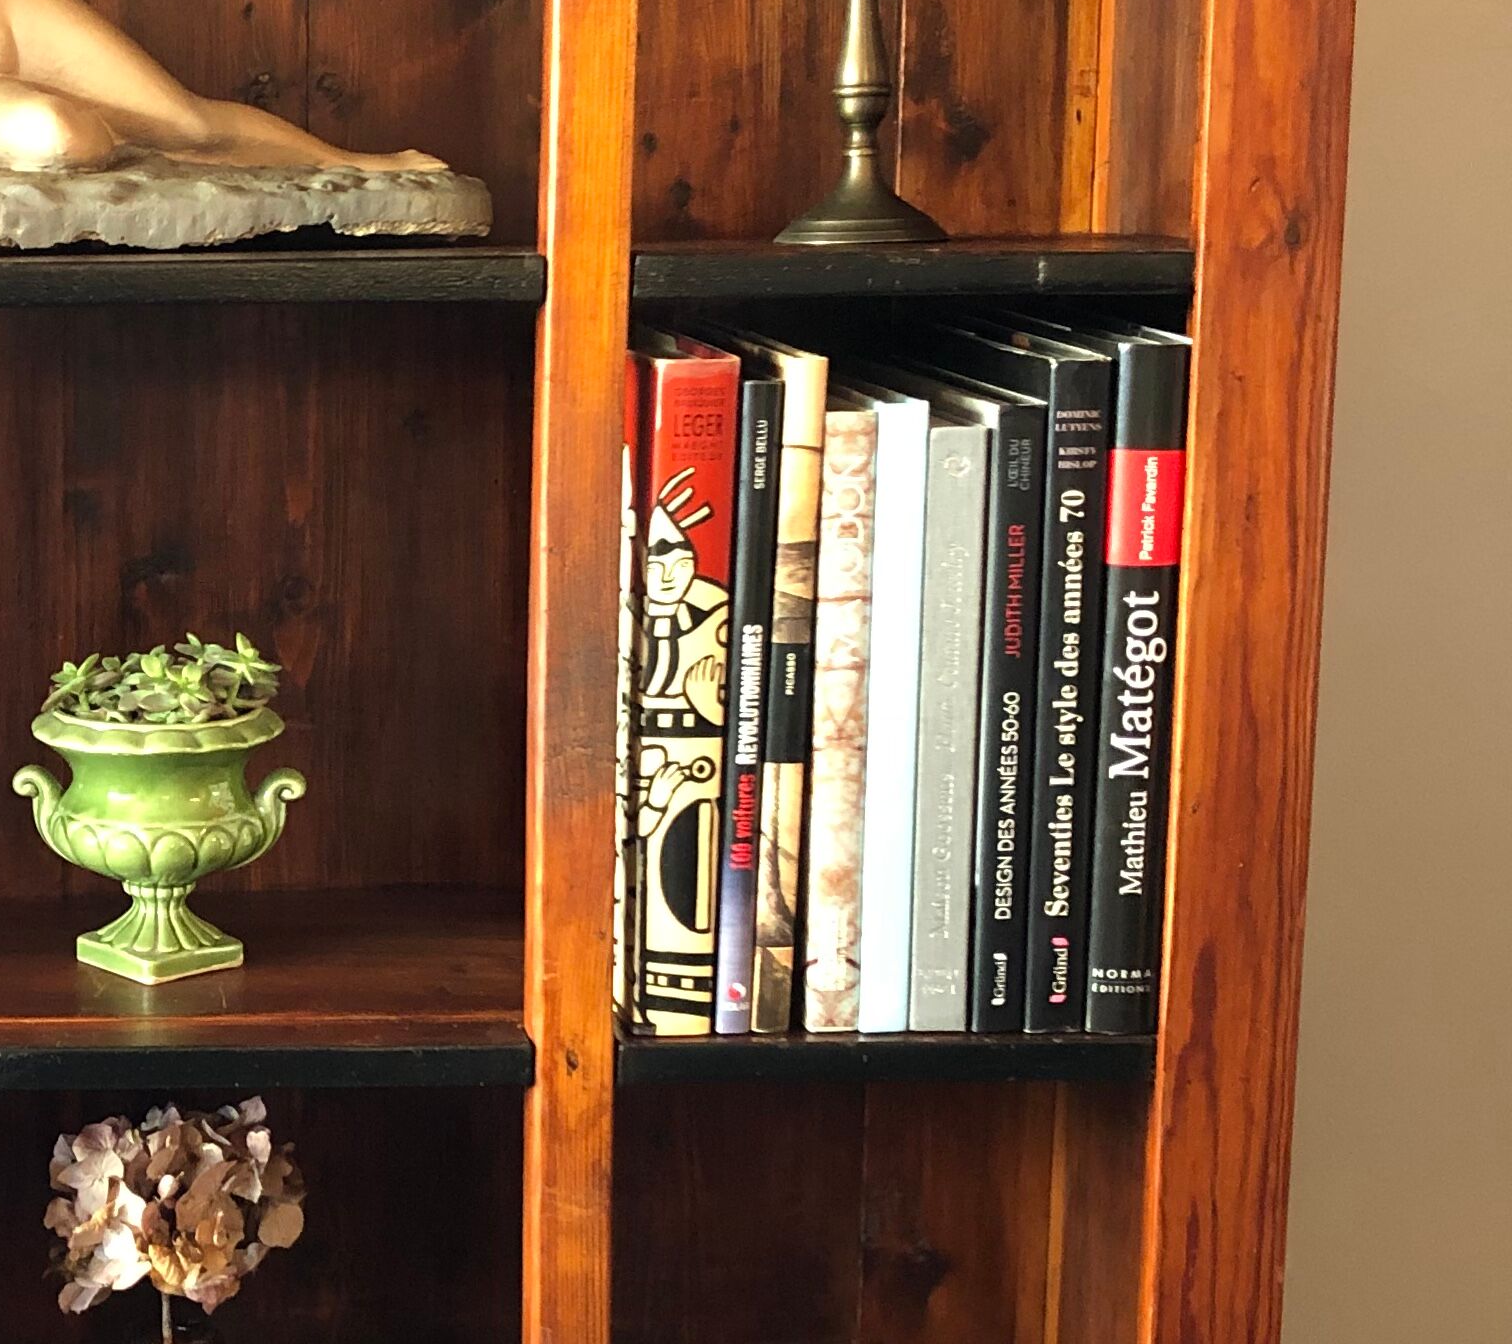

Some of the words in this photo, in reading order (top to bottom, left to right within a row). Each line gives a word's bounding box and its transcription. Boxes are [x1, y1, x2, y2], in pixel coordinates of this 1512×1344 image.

[755, 419, 768, 453] BELLU
[1010, 439, 1020, 455] DU
[753, 456, 767, 489] SERGE
[1019, 439, 1032, 491] CHINEUR
[1141, 456, 1159, 512] Favardin
[1059, 489, 1085, 523] 70
[1008, 524, 1025, 590] MILLER
[1139, 516, 1156, 561] Patrick
[1057, 530, 1084, 624] années
[1004, 592, 1023, 657] JUDITH
[785, 653, 796, 695] PICASSO
[1054, 632, 1081, 677] des
[735, 624, 763, 765] REVOLUTIONNAIRES
[1108, 590, 1168, 780] Matégot
[1001, 691, 1020, 742] 50-60
[1051, 684, 1084, 746] style
[996, 745, 1019, 815] ANNÉES
[1049, 752, 1076, 786] Le
[732, 773, 755, 838] voitures
[729, 843, 752, 870] 100
[997, 817, 1014, 852] DES
[1044, 794, 1073, 917] Seventies
[1119, 790, 1148, 896] Mathieu
[994, 856, 1013, 920] DESIGN
[1052, 948, 1069, 993] Gründ
[1092, 968, 1151, 979] NORMA
